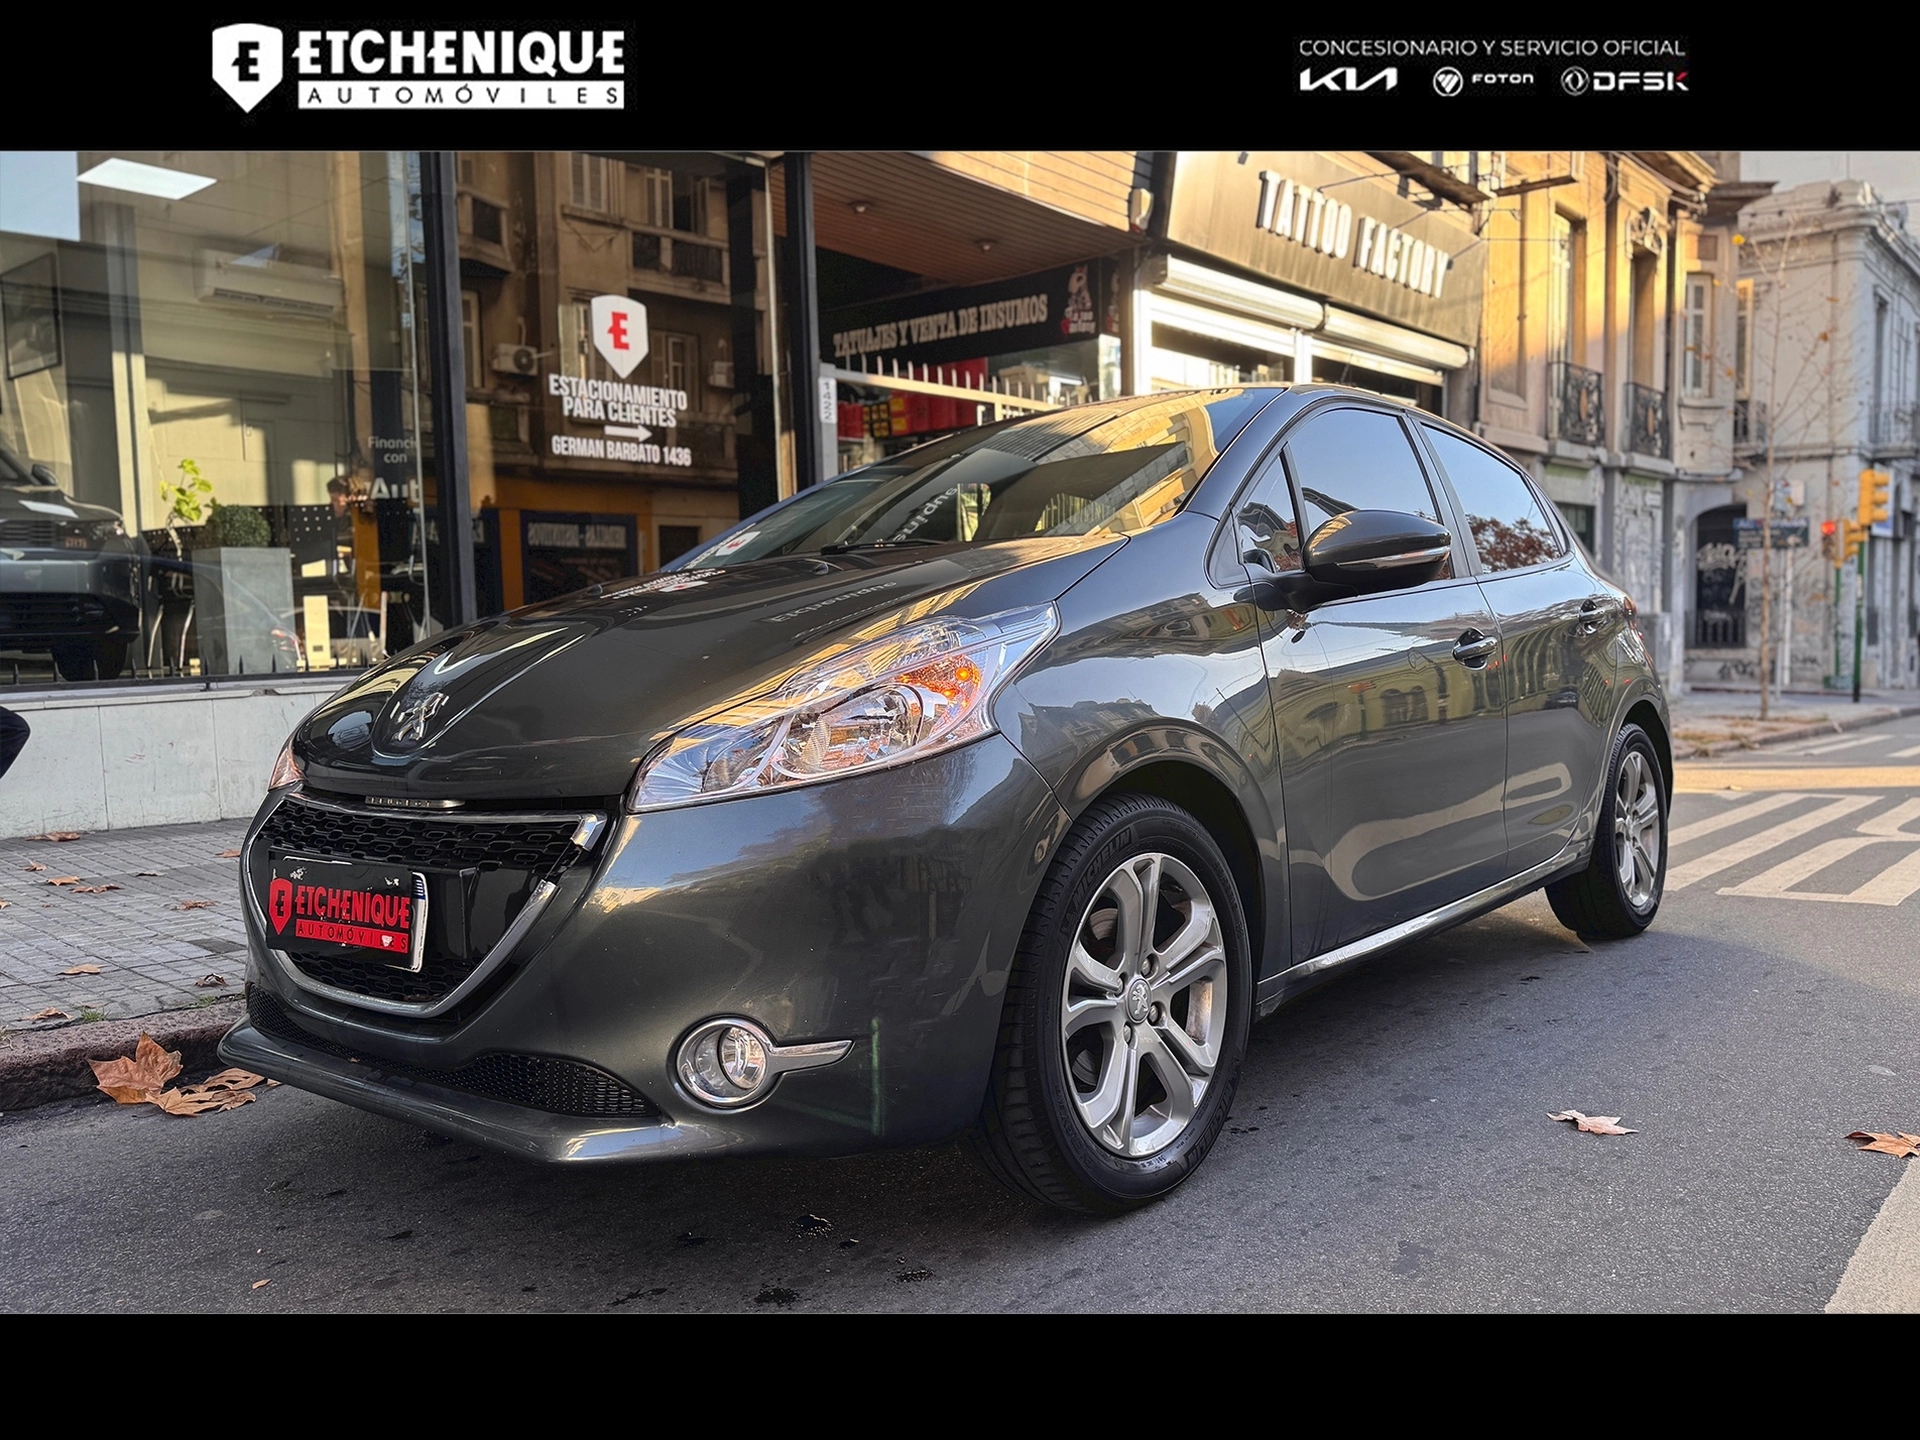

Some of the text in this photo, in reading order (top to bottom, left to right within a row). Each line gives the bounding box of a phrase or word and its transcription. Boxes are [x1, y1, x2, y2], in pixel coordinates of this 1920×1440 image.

[1257, 170, 1450, 299] TATTOO FACTORY
[833, 321, 898, 358] TATUAJES
[897, 320, 909, 347] Y
[908, 311, 958, 344] VENTA
[957, 306, 979, 336] DE
[979, 294, 1049, 332] INSUMOS
[548, 373, 688, 411] ESTACIONAMIENTO
[562, 395, 677, 428] PARA CLIENTES
[383, 453, 408, 463] con
[552, 435, 692, 467] GERMAN BARBATO 1436
[295, 885, 411, 929] ETCHENIQUE
